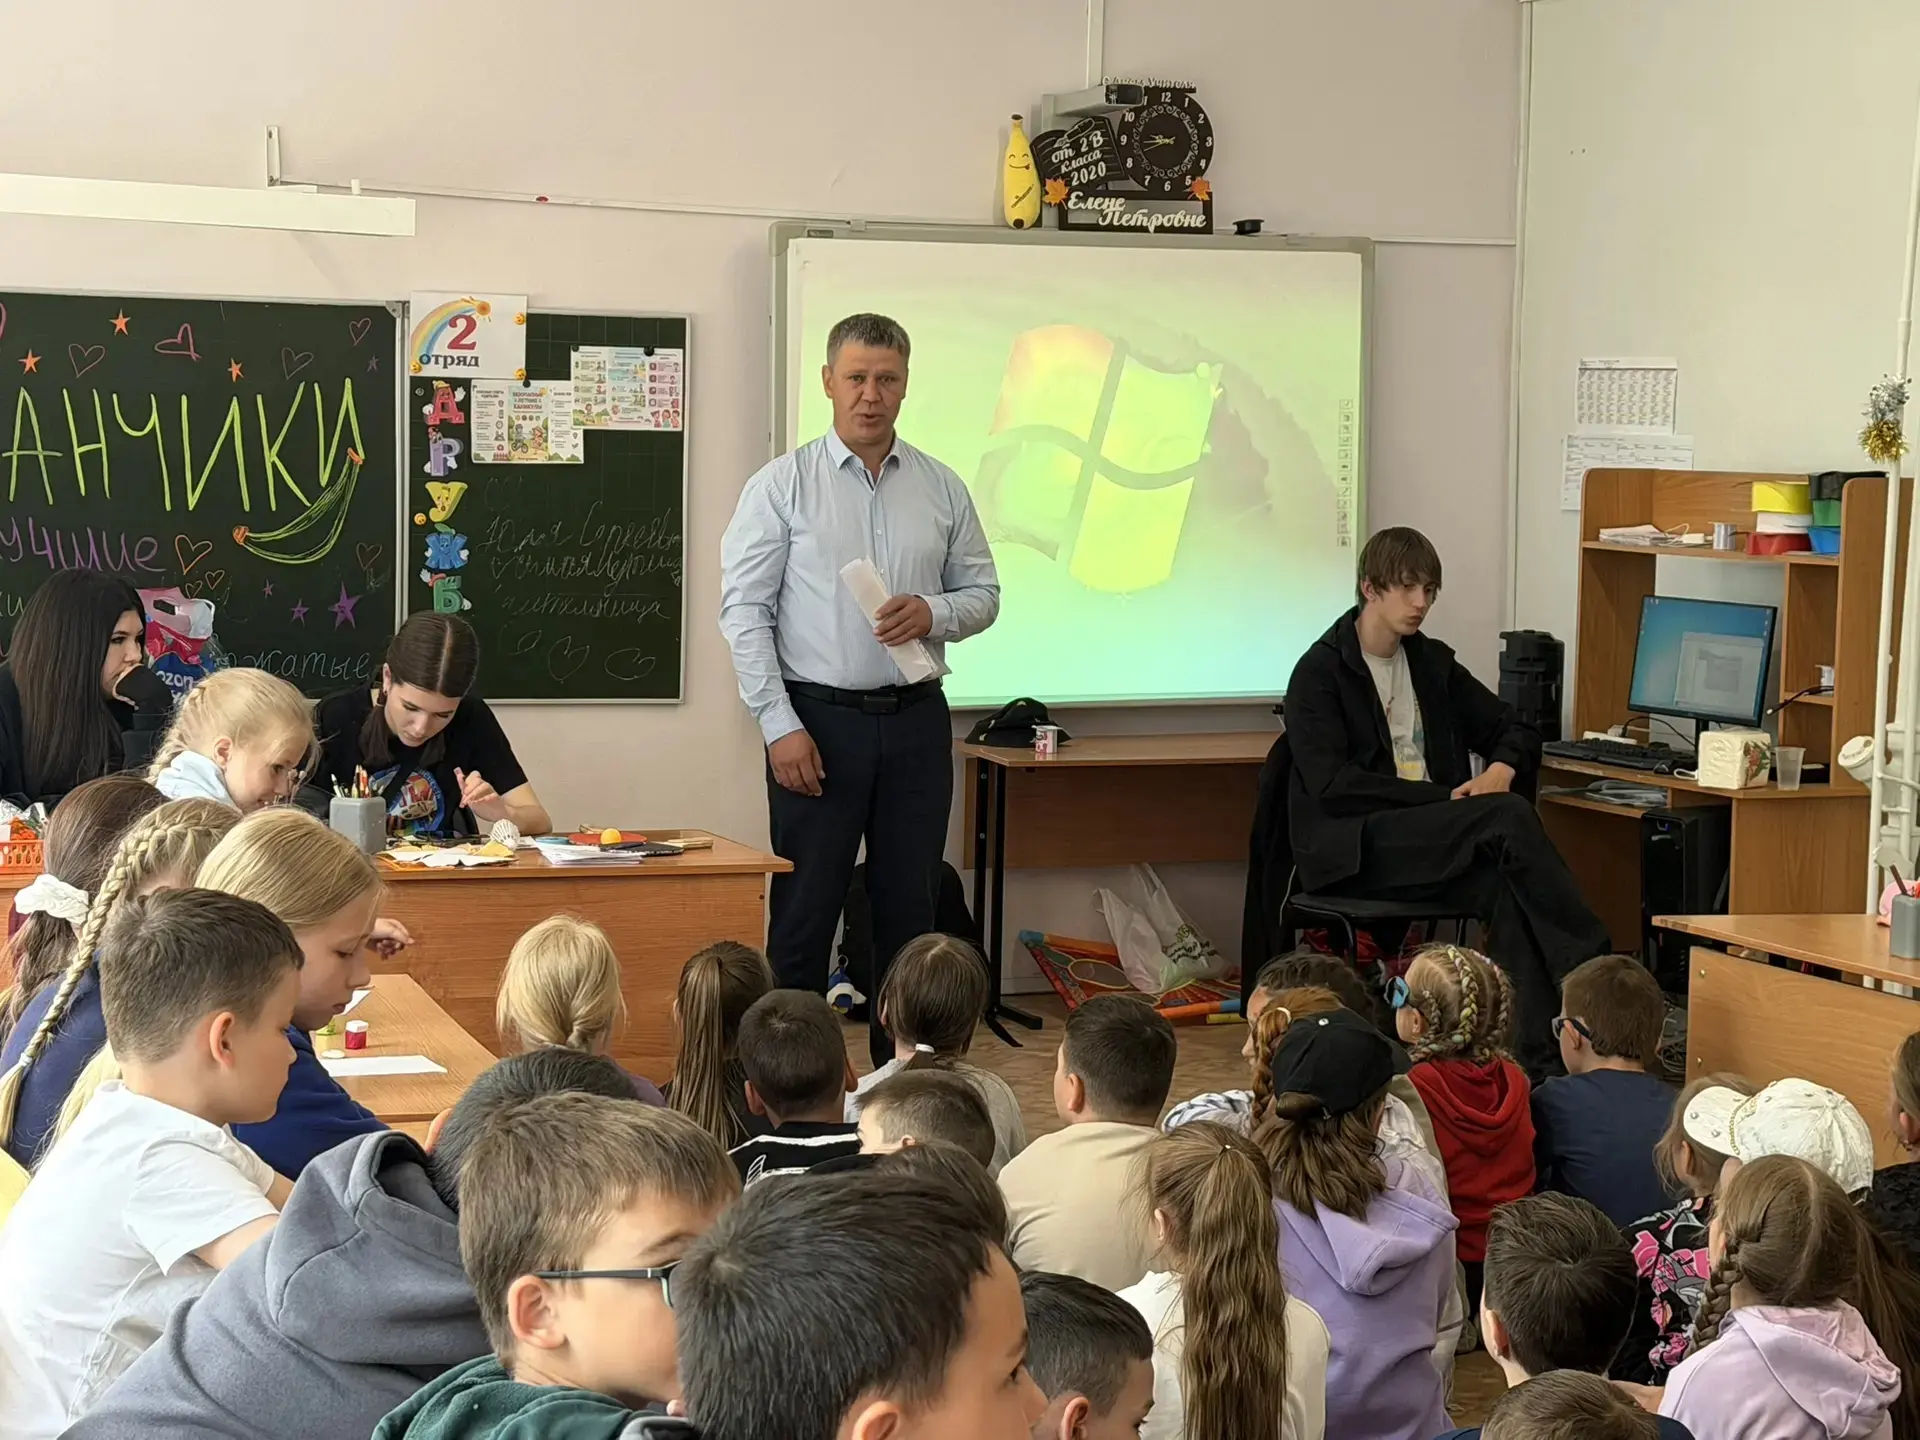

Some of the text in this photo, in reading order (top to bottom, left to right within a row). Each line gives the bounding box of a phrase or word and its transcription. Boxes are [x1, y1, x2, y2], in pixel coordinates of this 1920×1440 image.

[1161, 92, 1172, 103] 12
[1124, 111, 1136, 122] 10
[1198, 113, 1205, 124] 2
[1120, 134, 1128, 146] 9
[1205, 136, 1213, 147] 3
[1051, 143, 1076, 163] от
[1126, 157, 1134, 168] 8
[1199, 159, 1206, 170] 4
[1070, 161, 1107, 187] 2020
[1144, 175, 1152, 186] 7
[1164, 181, 1171, 191] 6
[1185, 175, 1192, 186] 5
[1068, 191, 1126, 211] Елене
[1098, 208, 1208, 234] Петровне
[447, 314, 477, 351] 2
[419, 353, 480, 370] отряд
[226, 650, 372, 681] ожатые
